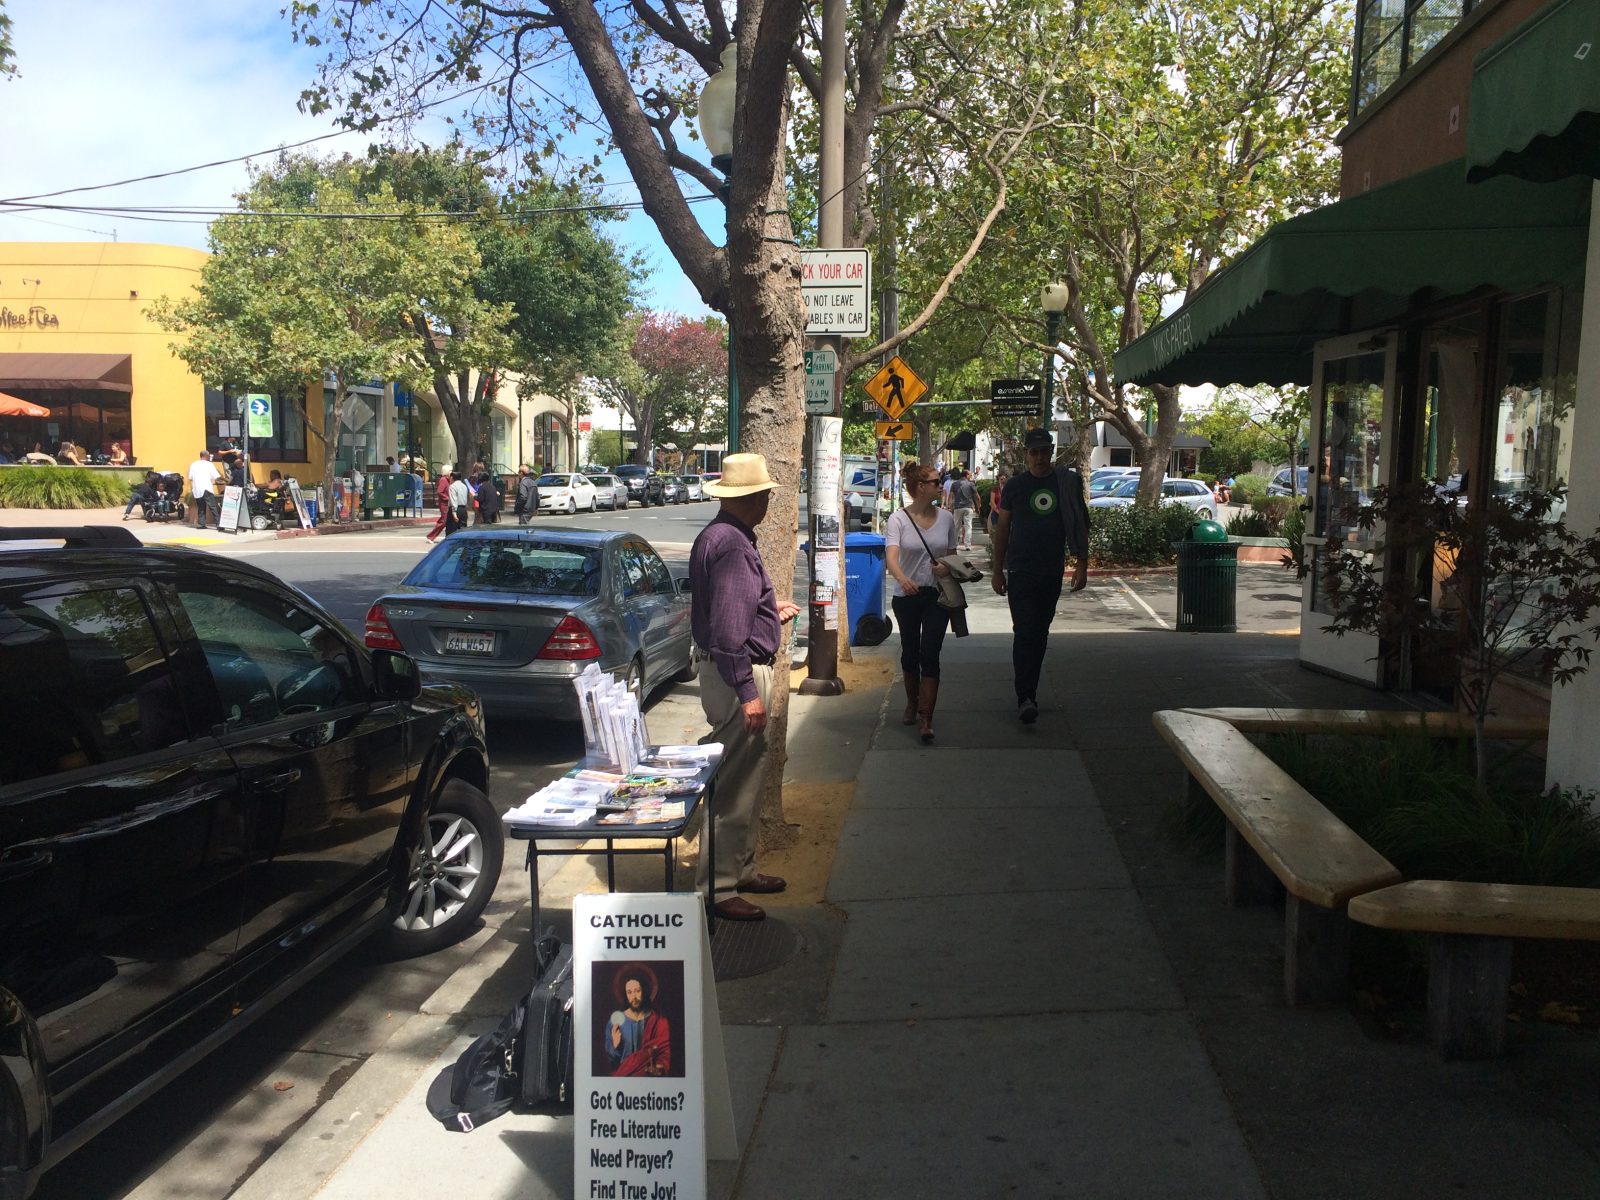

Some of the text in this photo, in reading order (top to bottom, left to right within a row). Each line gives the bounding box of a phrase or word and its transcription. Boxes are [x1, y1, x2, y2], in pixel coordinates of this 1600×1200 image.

[818, 263, 842, 279] YOUR
[846, 263, 863, 279] CAR
[802, 294, 854, 307] O NOT LEAVE
[29, 305, 60, 330] Tea
[808, 312, 863, 325] ABLES IN CAR
[805, 357, 812, 370] 2
[812, 362, 833, 371] PARKING
[810, 379, 825, 387] 9 AM
[806, 390, 829, 399] TO 6 PM
[590, 913, 684, 928] CATHOLIC
[603, 935, 666, 950] TRUTH
[590, 1090, 685, 1112] Got Questions?
[590, 1118, 682, 1140] Free Literature
[590, 1148, 674, 1174] Need Prayer?
[590, 1179, 677, 1200] Find True Joy!
